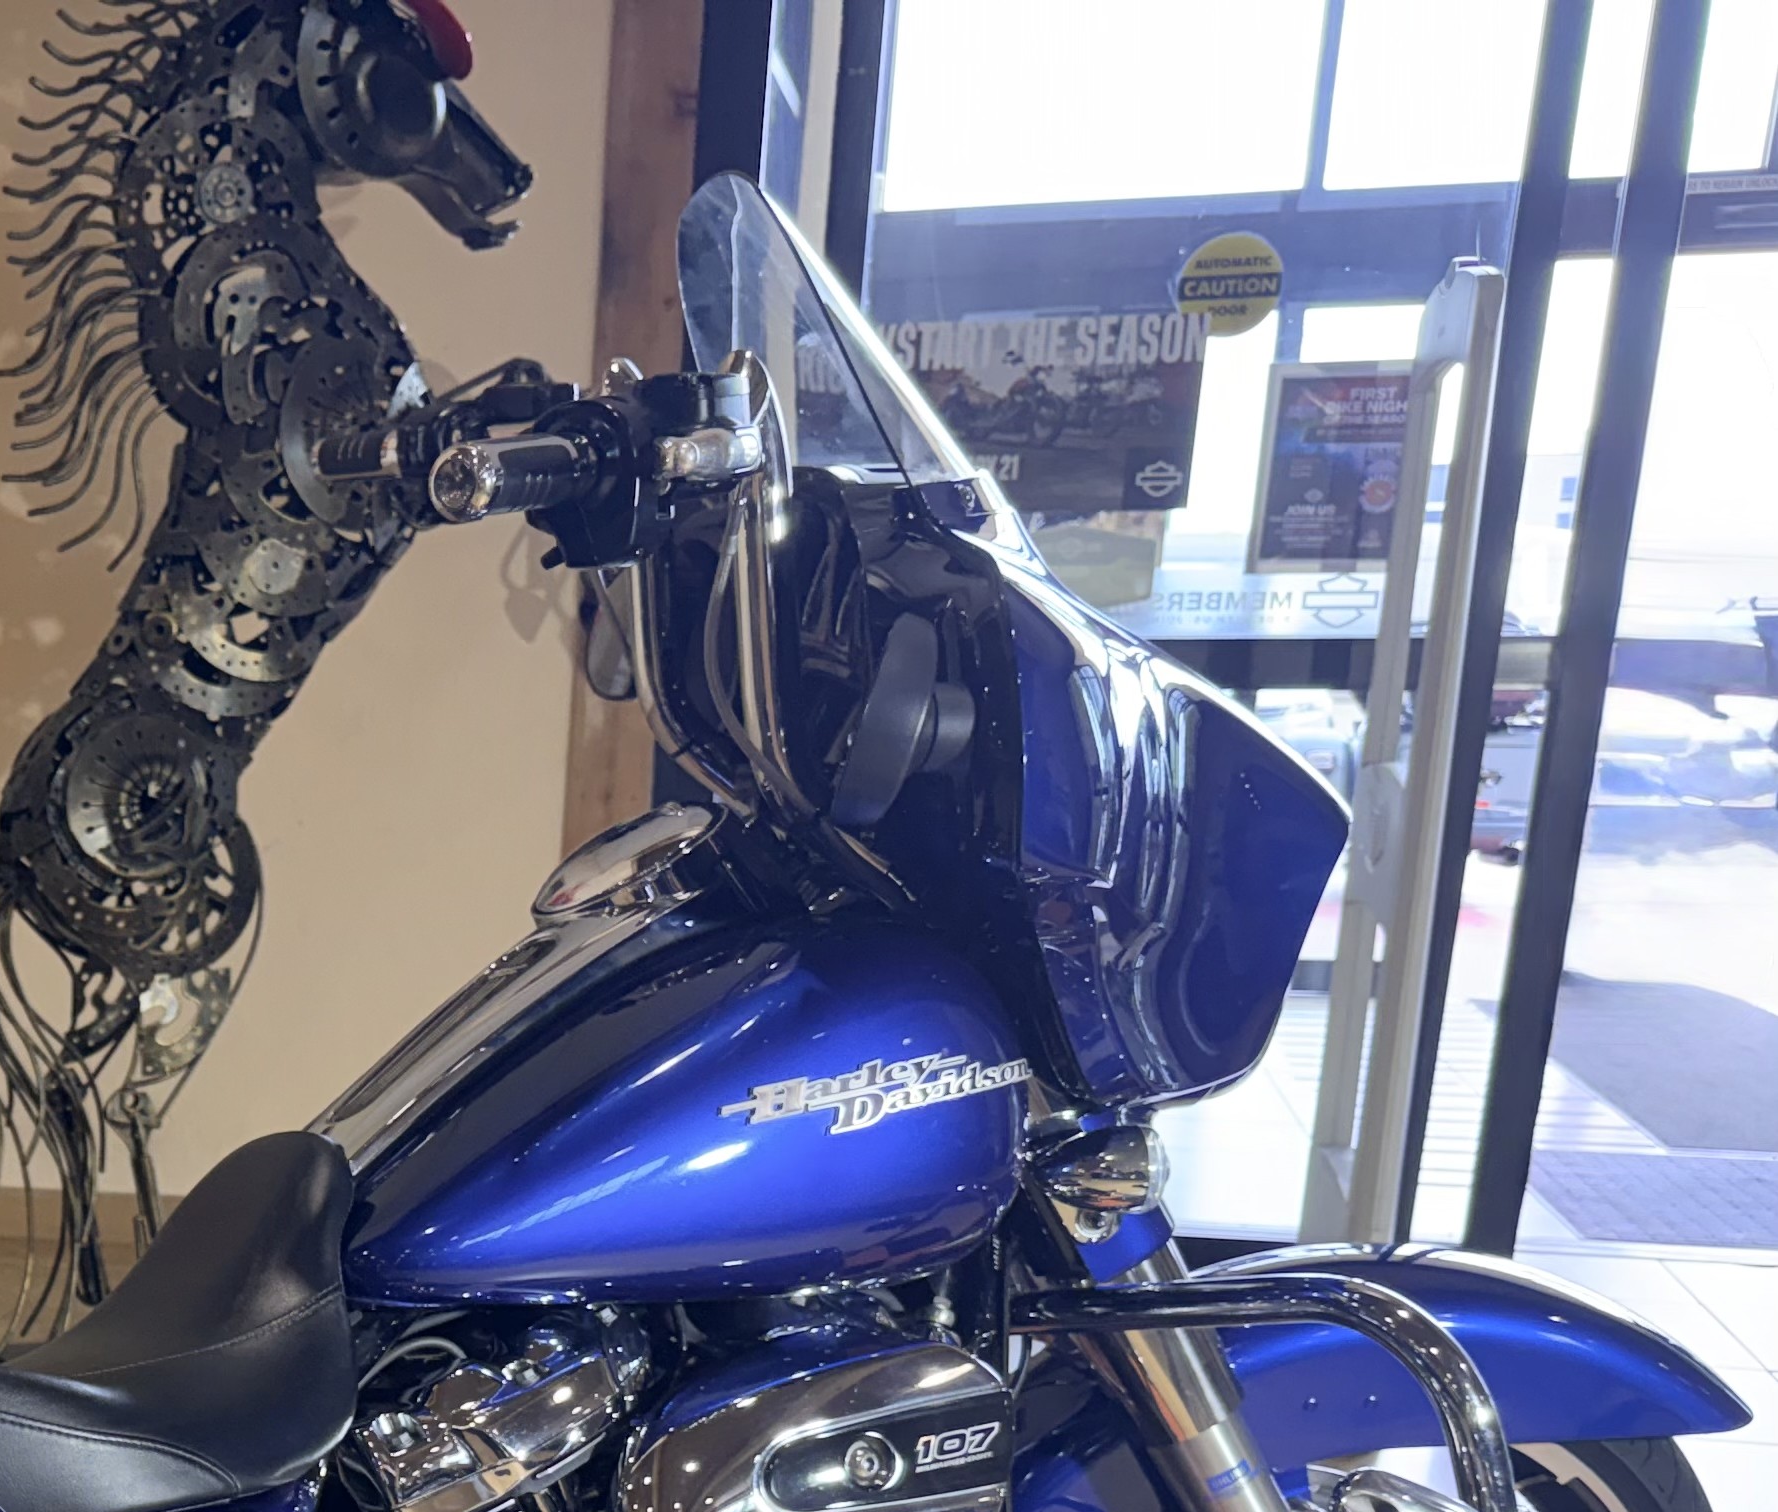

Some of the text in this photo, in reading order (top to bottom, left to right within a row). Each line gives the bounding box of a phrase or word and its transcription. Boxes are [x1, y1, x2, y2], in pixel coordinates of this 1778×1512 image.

[1193, 255, 1272, 270] AUTOMATIC
[1183, 277, 1278, 297] CAUTION
[1003, 316, 1069, 367] THE
[1075, 311, 1213, 366] SEASON
[1350, 386, 1399, 400] FIRST
[999, 453, 1021, 481] 21
[718, 1052, 968, 1126] Harley
[825, 1057, 1033, 1137] Davidson
[915, 1421, 1000, 1465] 107
